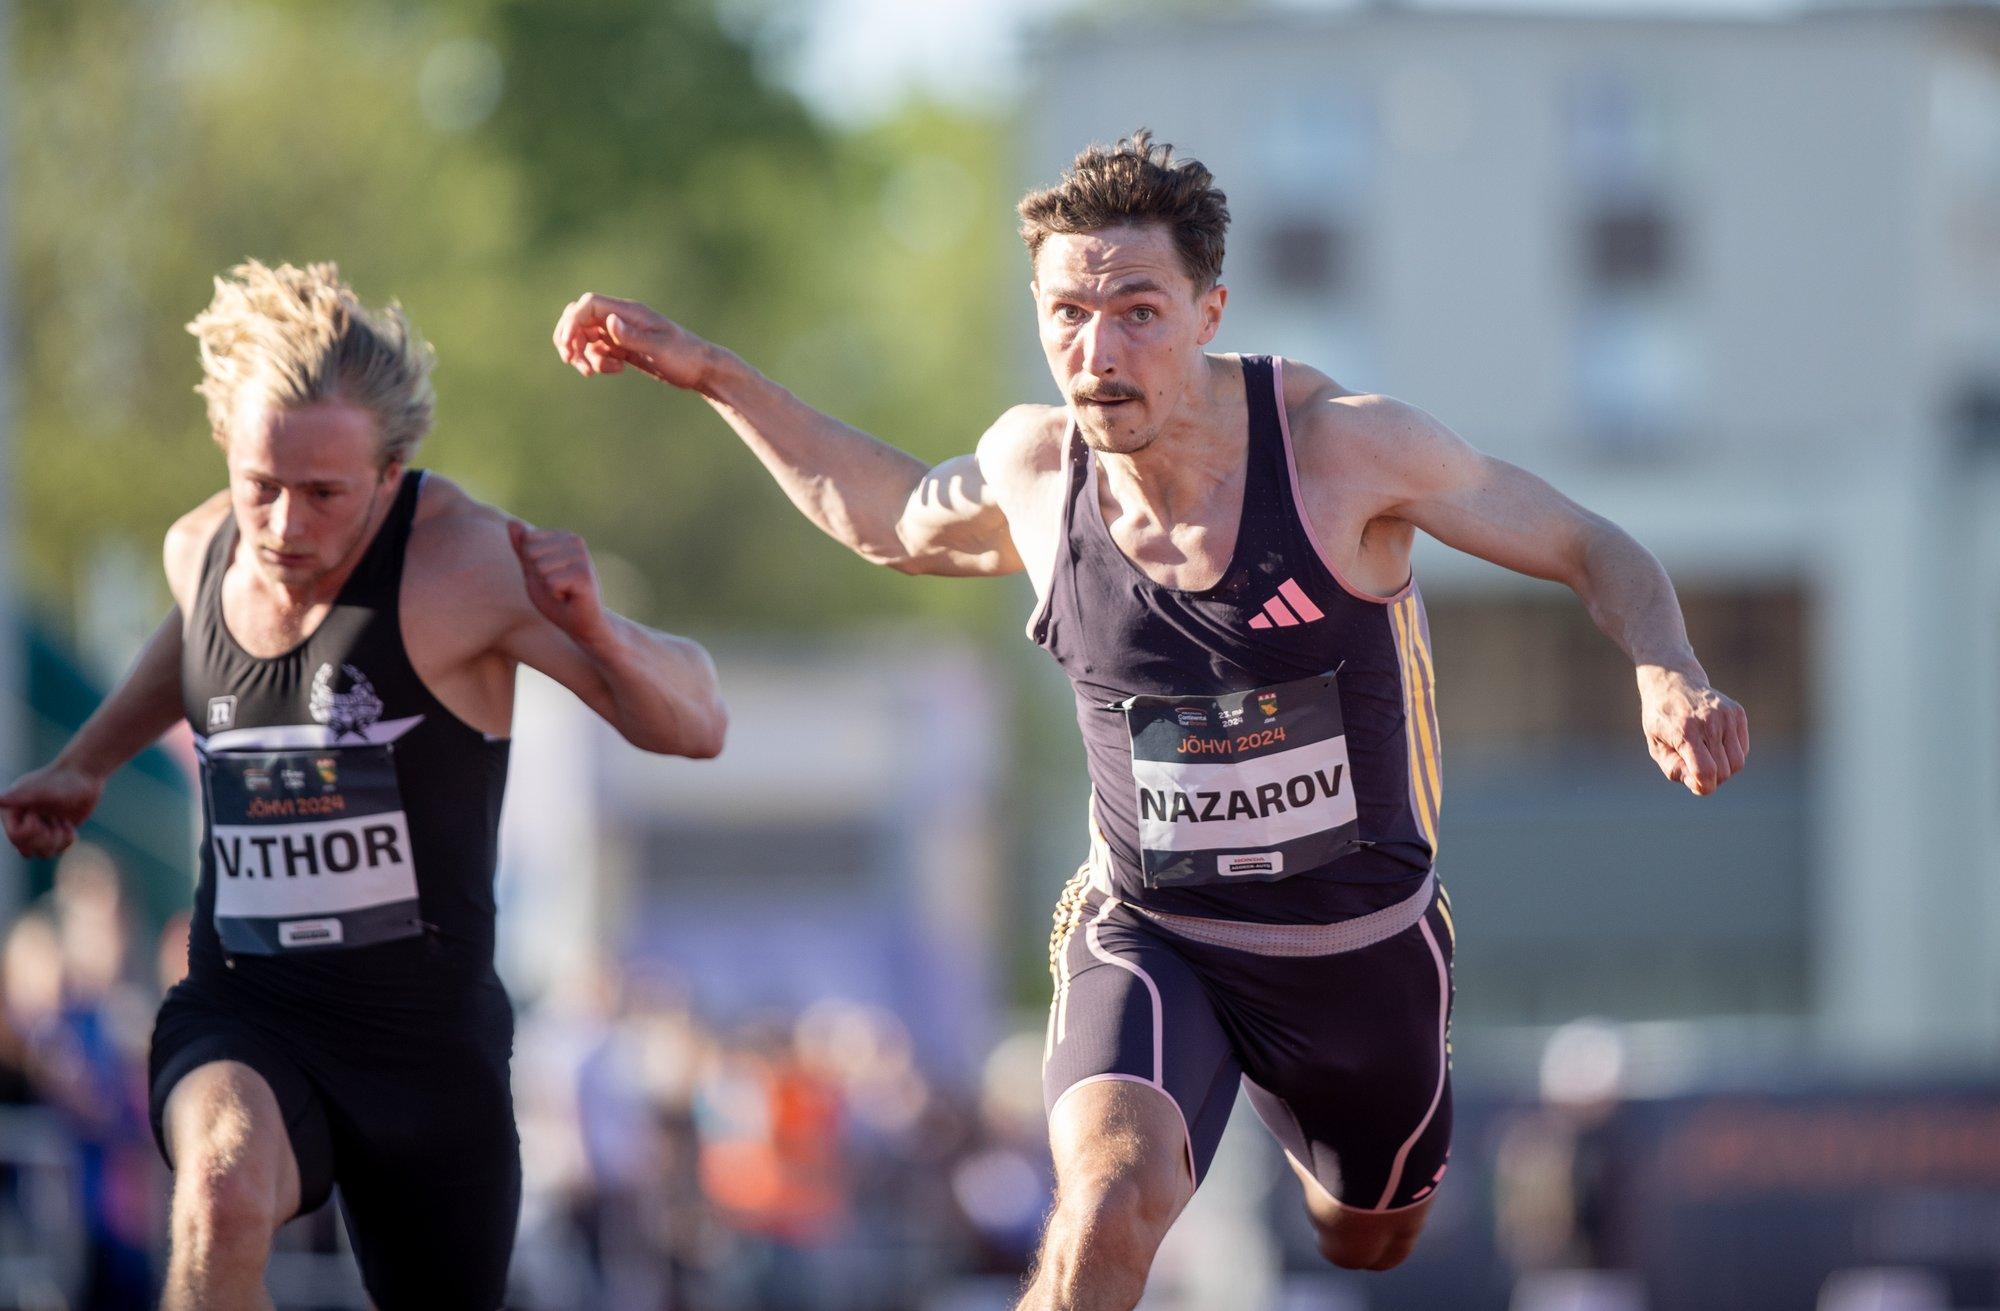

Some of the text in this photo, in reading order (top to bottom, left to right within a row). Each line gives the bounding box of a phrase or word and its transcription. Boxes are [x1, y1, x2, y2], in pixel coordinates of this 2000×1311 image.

[1222, 717, 1243, 727] 2024
[1177, 727, 1286, 754] JÕHVI 2024
[298, 795, 345, 815] 2024
[1140, 764, 1343, 823] NAZAROV
[214, 824, 402, 878] V.THOR
